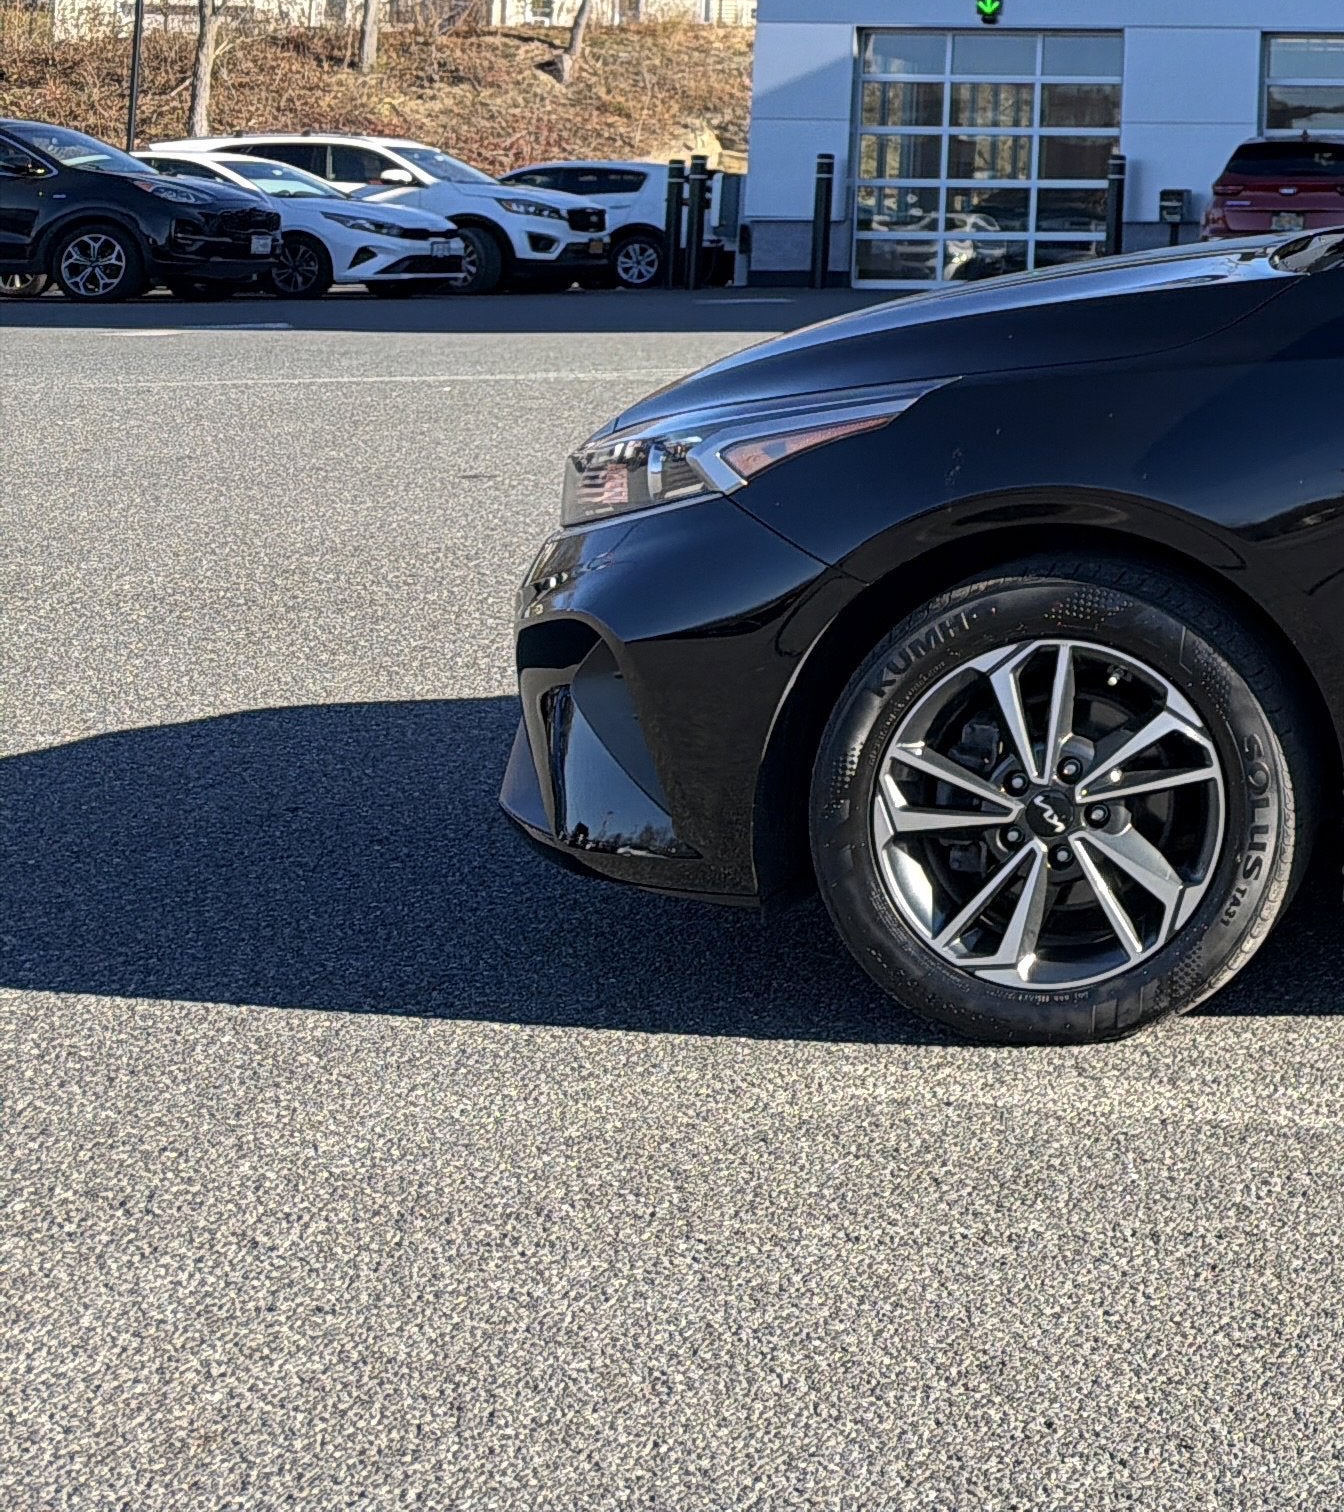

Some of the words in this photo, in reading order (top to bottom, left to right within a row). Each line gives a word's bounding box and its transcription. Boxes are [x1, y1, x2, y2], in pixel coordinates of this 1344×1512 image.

[871, 605, 997, 698] KUMH
[1242, 732, 1272, 881] SOLUS
[1219, 886, 1248, 928] TA31
